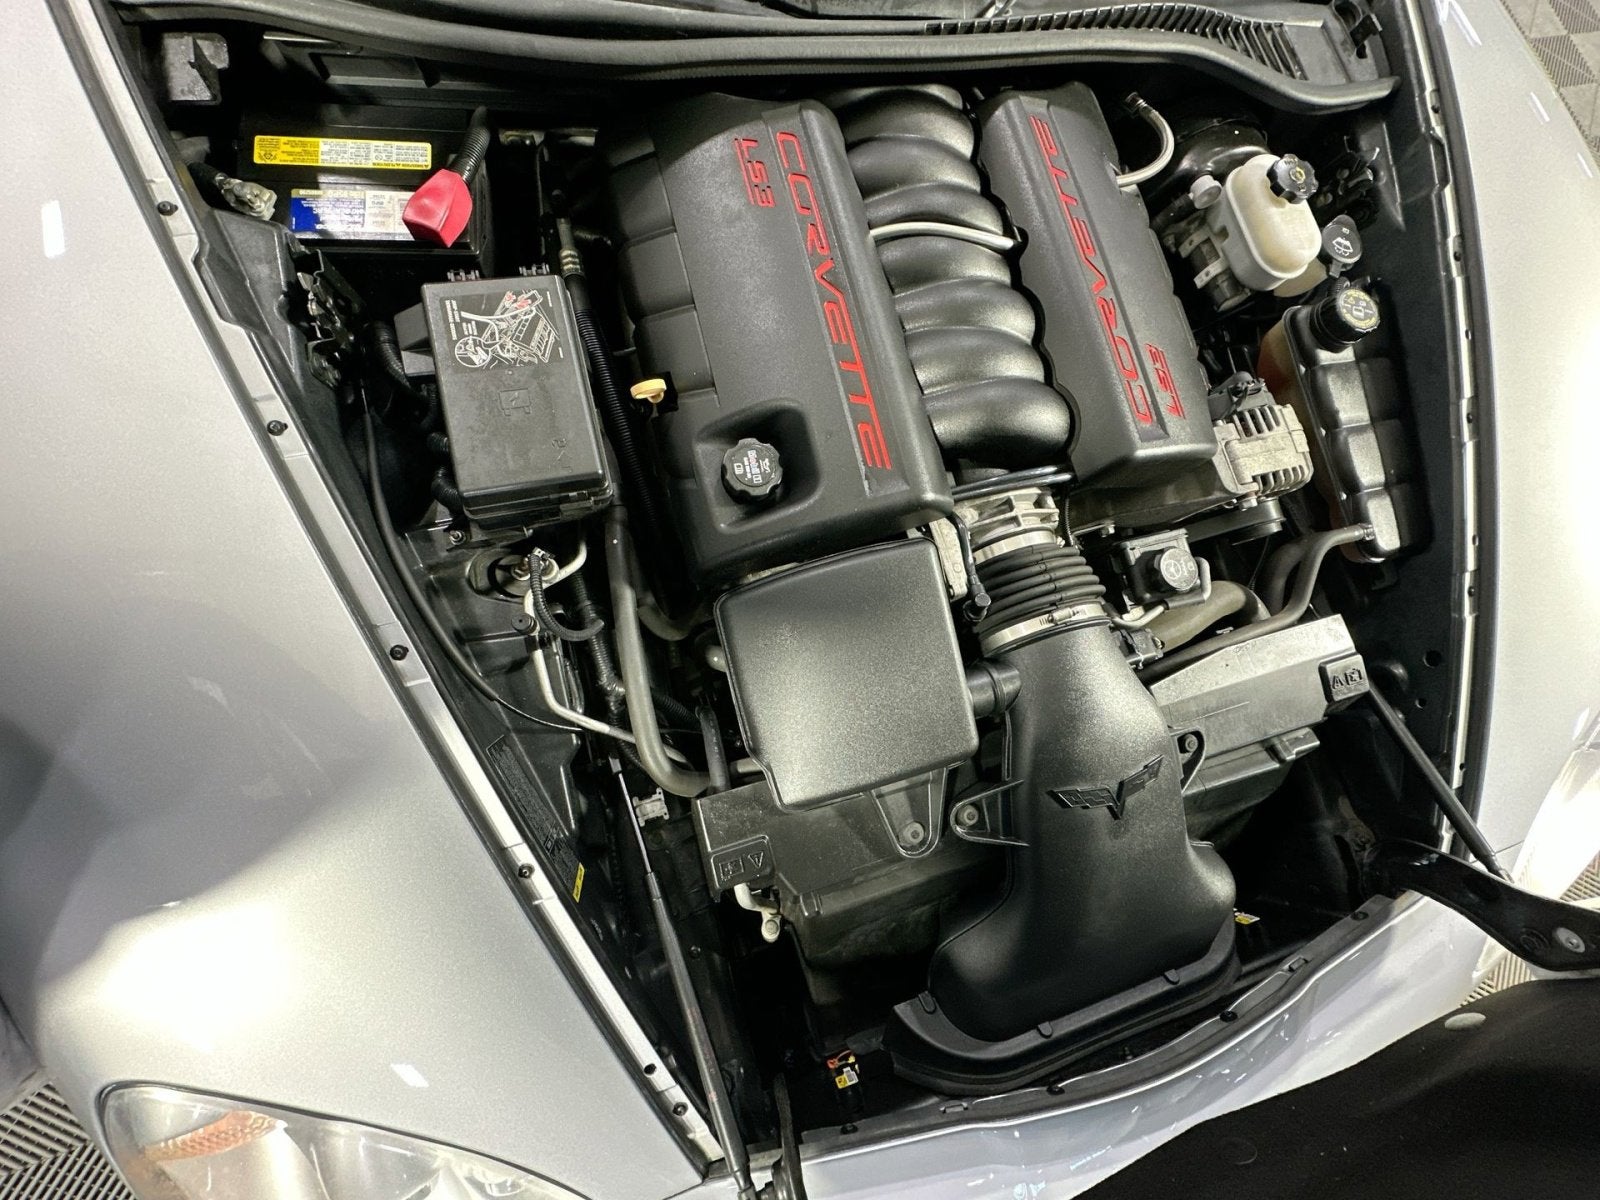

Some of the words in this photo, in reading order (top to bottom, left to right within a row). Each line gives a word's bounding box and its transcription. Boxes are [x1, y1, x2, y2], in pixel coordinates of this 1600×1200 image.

[734, 138, 776, 207] LS3
[1029, 114, 1152, 424] CORVETTE
[777, 132, 892, 470] CORVETTE
[1145, 342, 1186, 419] LS3
